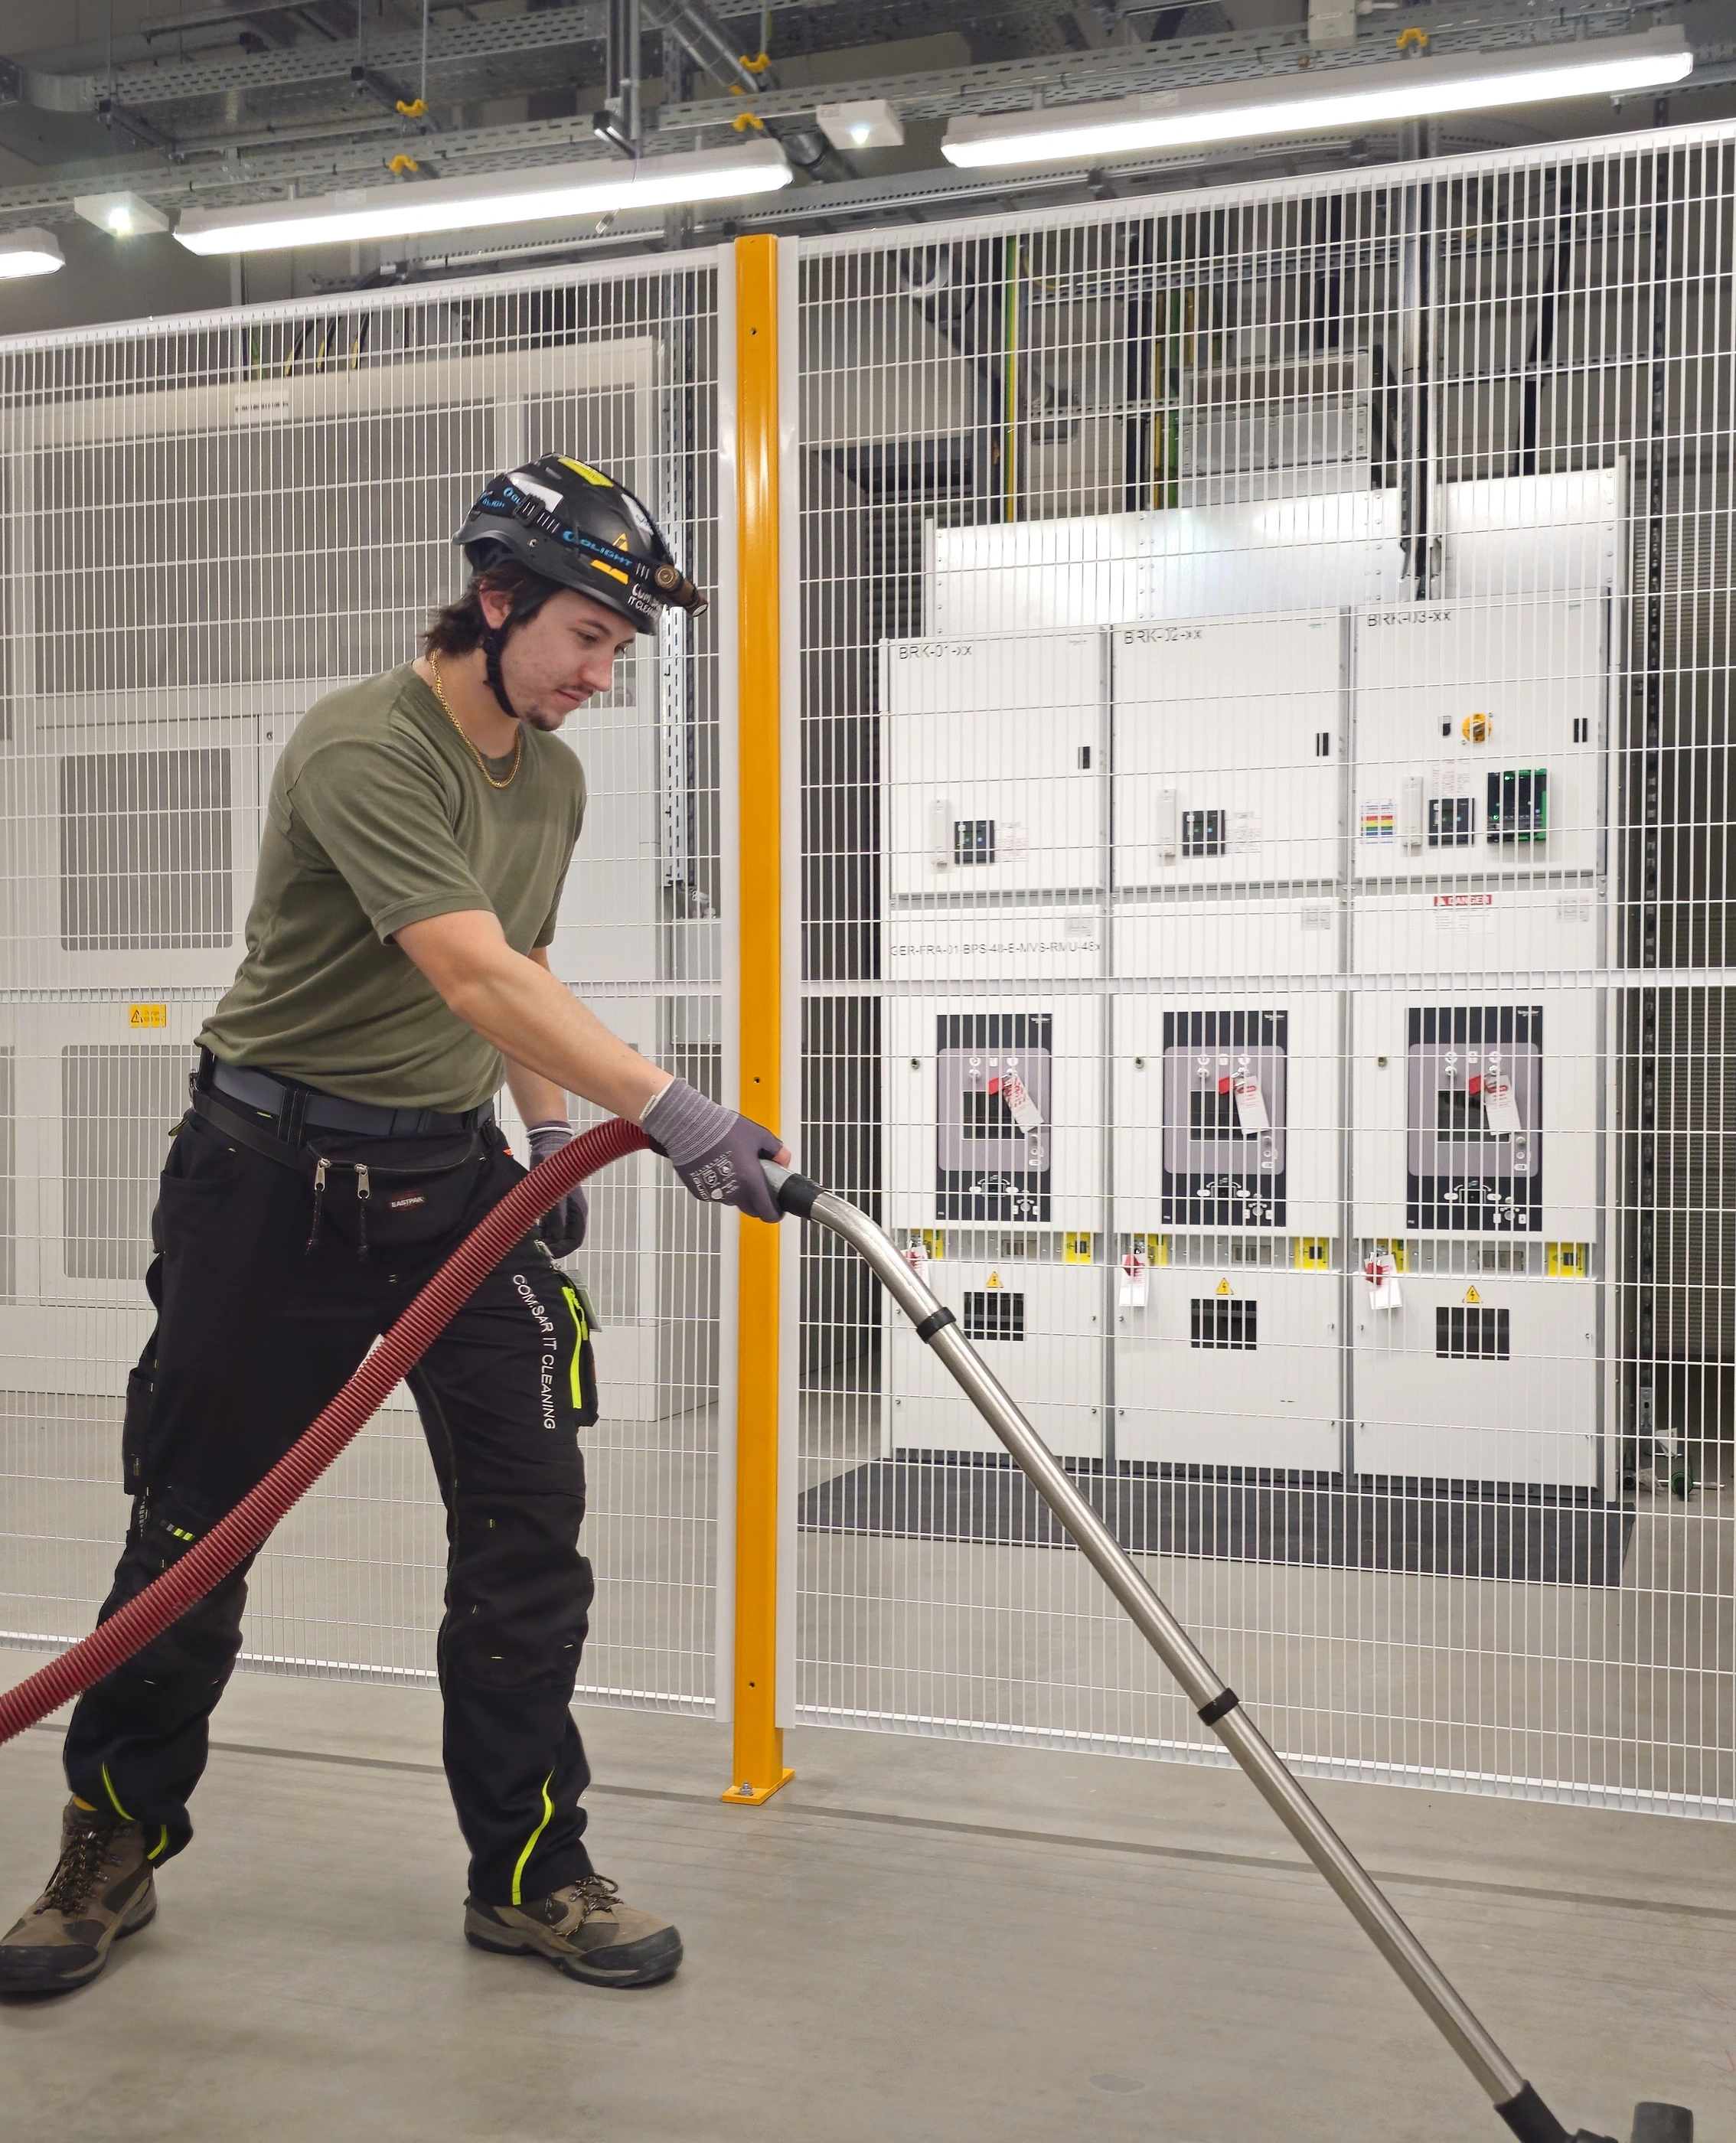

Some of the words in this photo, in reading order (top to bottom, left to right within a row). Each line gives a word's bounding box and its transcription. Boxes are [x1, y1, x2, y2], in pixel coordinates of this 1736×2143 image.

[1367, 612, 1451, 627] BRK-03-xx
[1124, 628, 1202, 644] BRK-02-xx
[391, 1196, 423, 1208] EASTPAK
[513, 1274, 554, 1333] COM.SAR
[543, 1338, 557, 1350] IT
[540, 1354, 556, 1430] CLEANING
